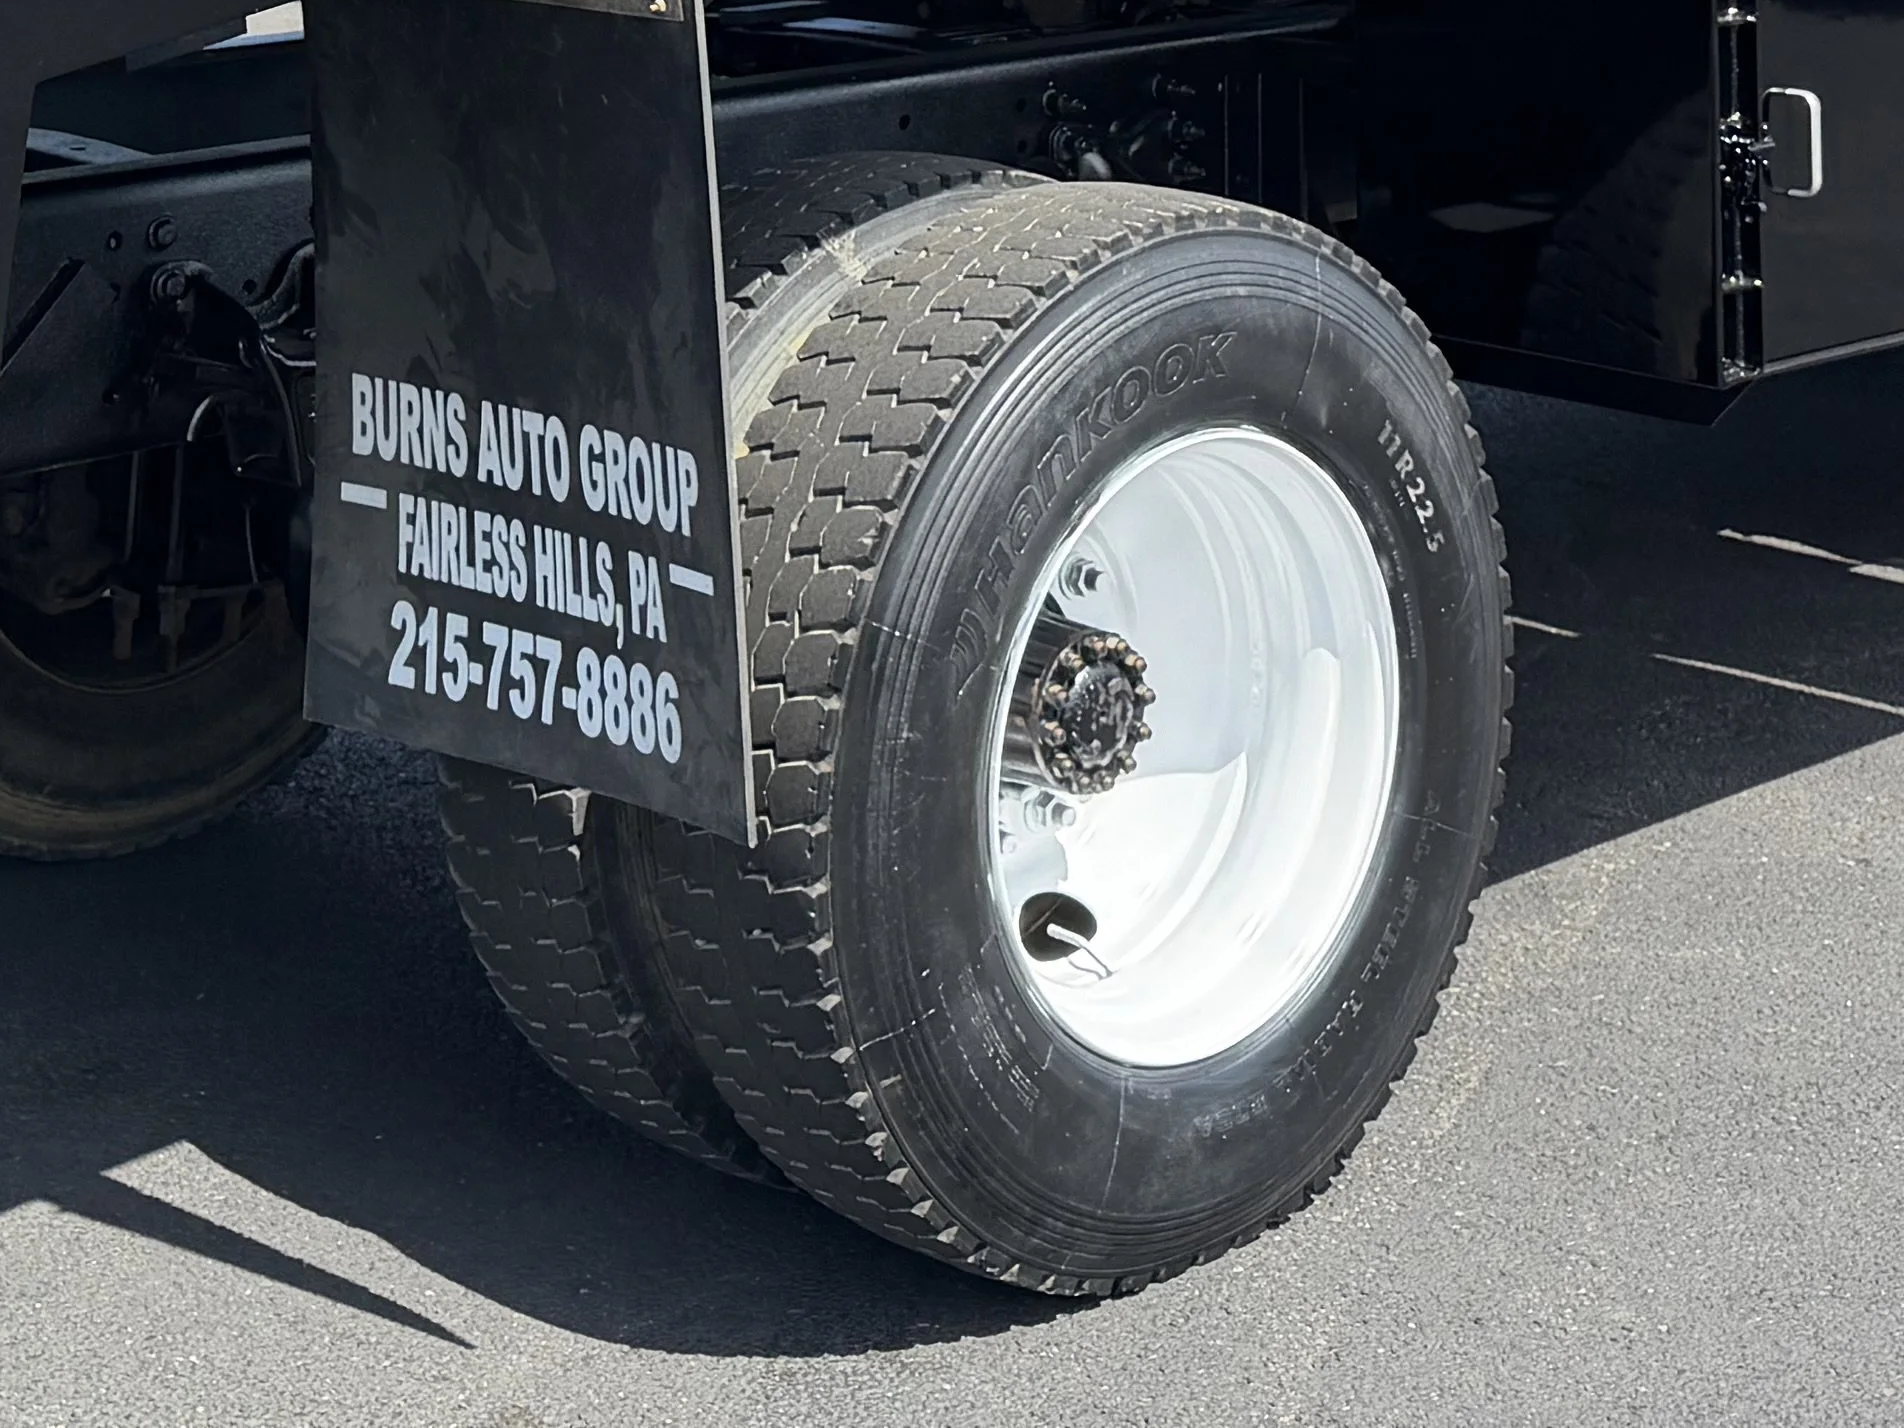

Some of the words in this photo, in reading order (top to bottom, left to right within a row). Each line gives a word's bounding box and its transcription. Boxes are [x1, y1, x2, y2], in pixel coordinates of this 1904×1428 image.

[352, 373, 469, 478] BURNS
[477, 400, 570, 503] AUTO
[580, 424, 699, 537] GROUP
[1377, 419, 1446, 553] 11R22.5
[398, 492, 527, 602] FAIRLESS
[534, 524, 624, 650] HILLS,
[628, 549, 668, 643] PA
[388, 600, 683, 764] 215-757-8886
